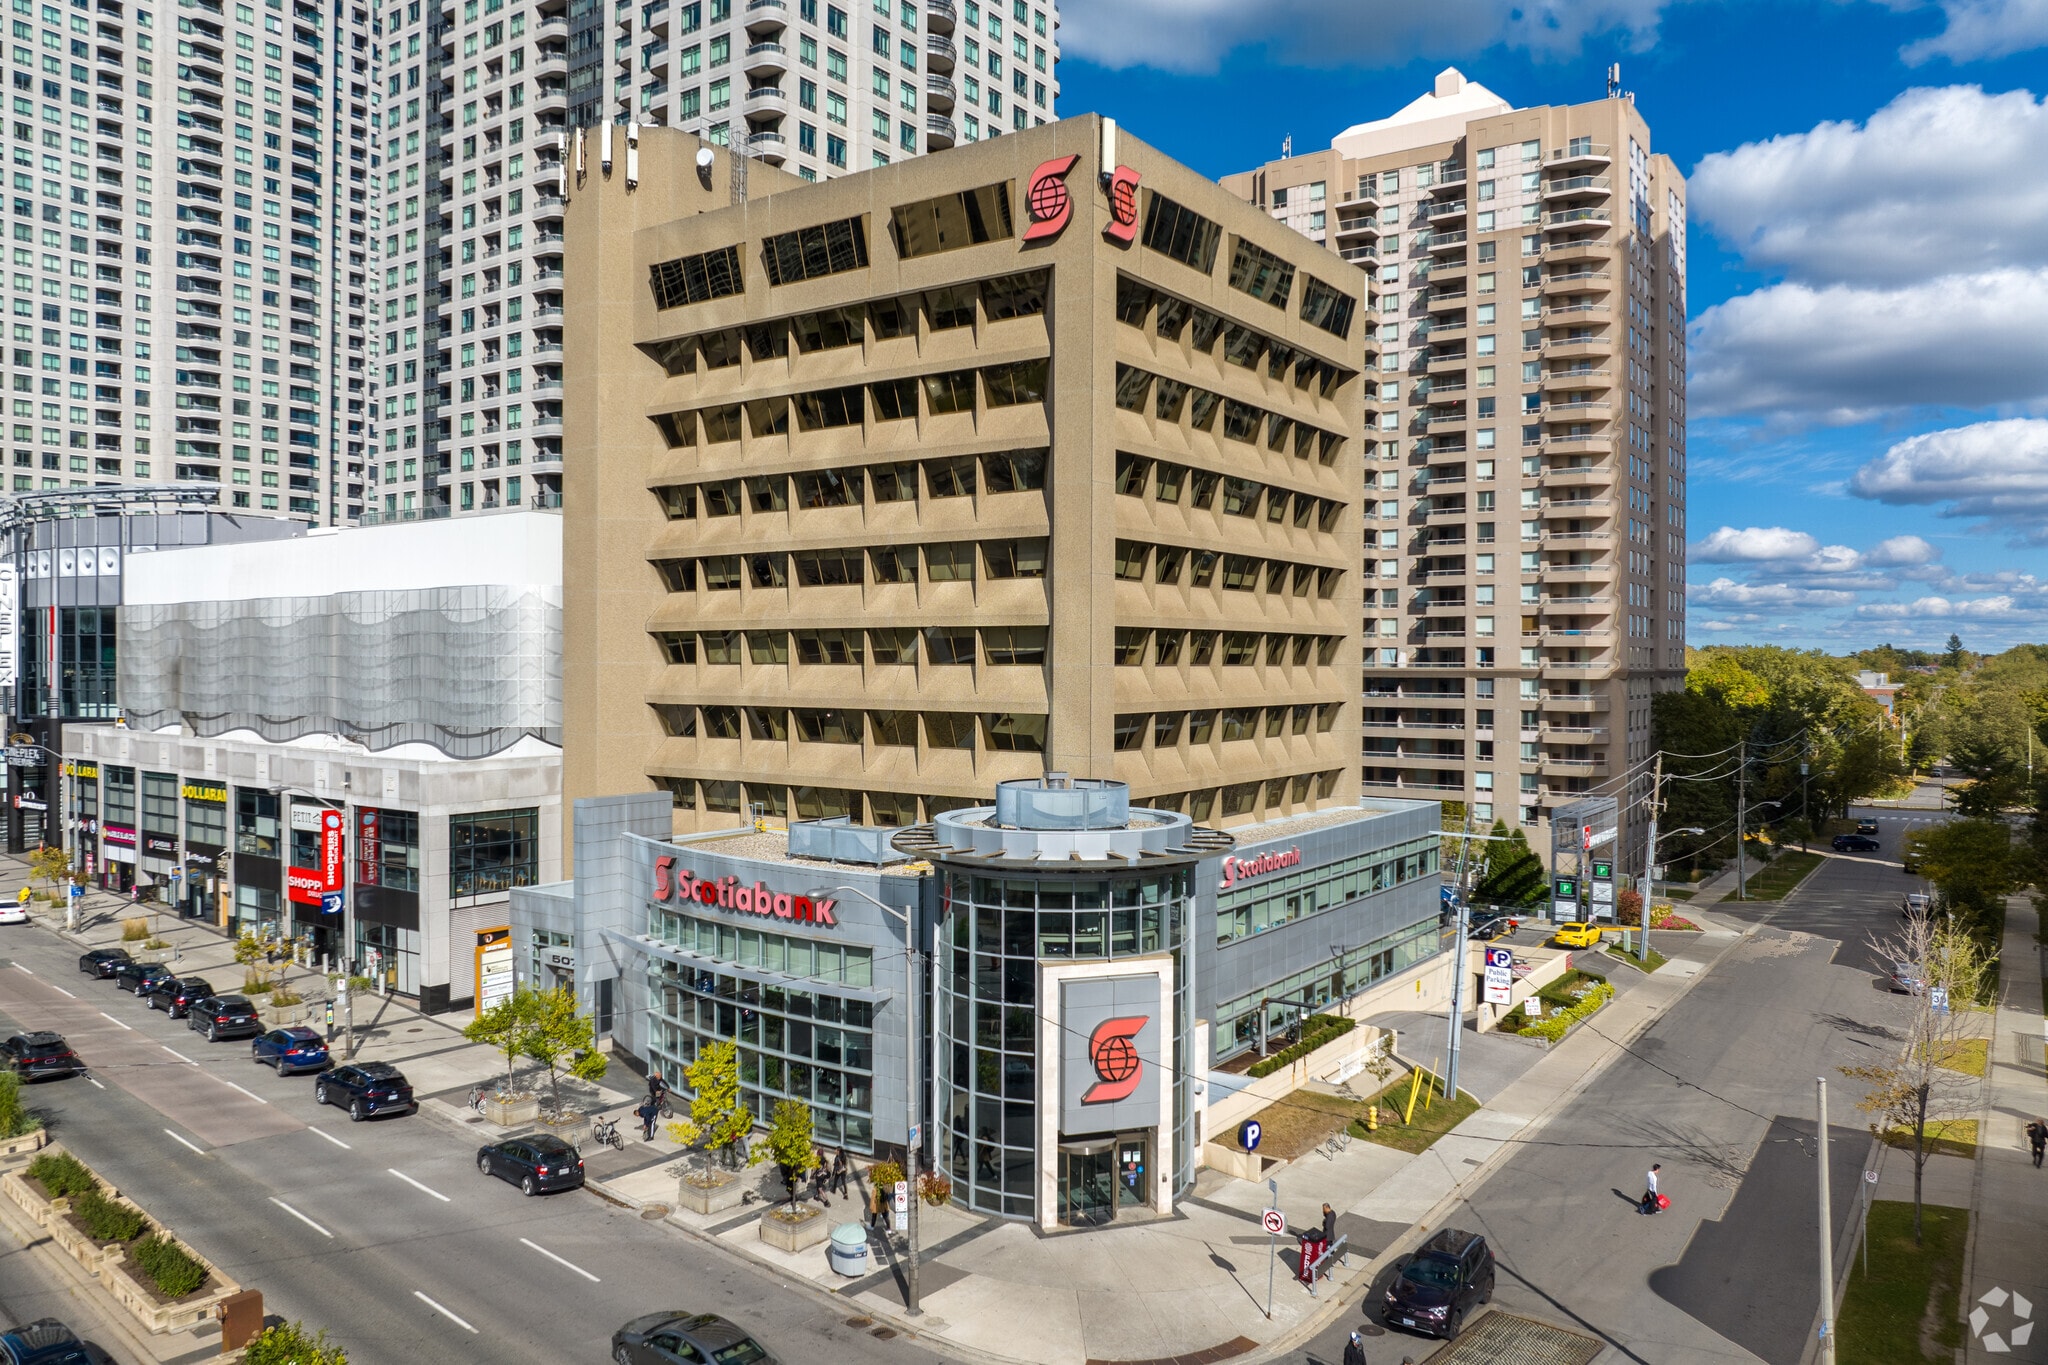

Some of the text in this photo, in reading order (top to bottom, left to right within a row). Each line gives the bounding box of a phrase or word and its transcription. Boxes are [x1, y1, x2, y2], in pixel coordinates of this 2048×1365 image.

[0, 569, 12, 684] CINEPLEX
[293, 811, 311, 823] PETIT
[327, 830, 335, 886] SHOPPERS
[1237, 845, 1300, 880] Scotiabank
[288, 876, 323, 891] SHOPP
[679, 870, 838, 925] Scotiabank
[1497, 953, 1509, 965] P
[1488, 968, 1507, 977] Public
[1486, 976, 1510, 986] Parking
[909, 1127, 917, 1141] P
[1247, 1124, 1260, 1148] P
